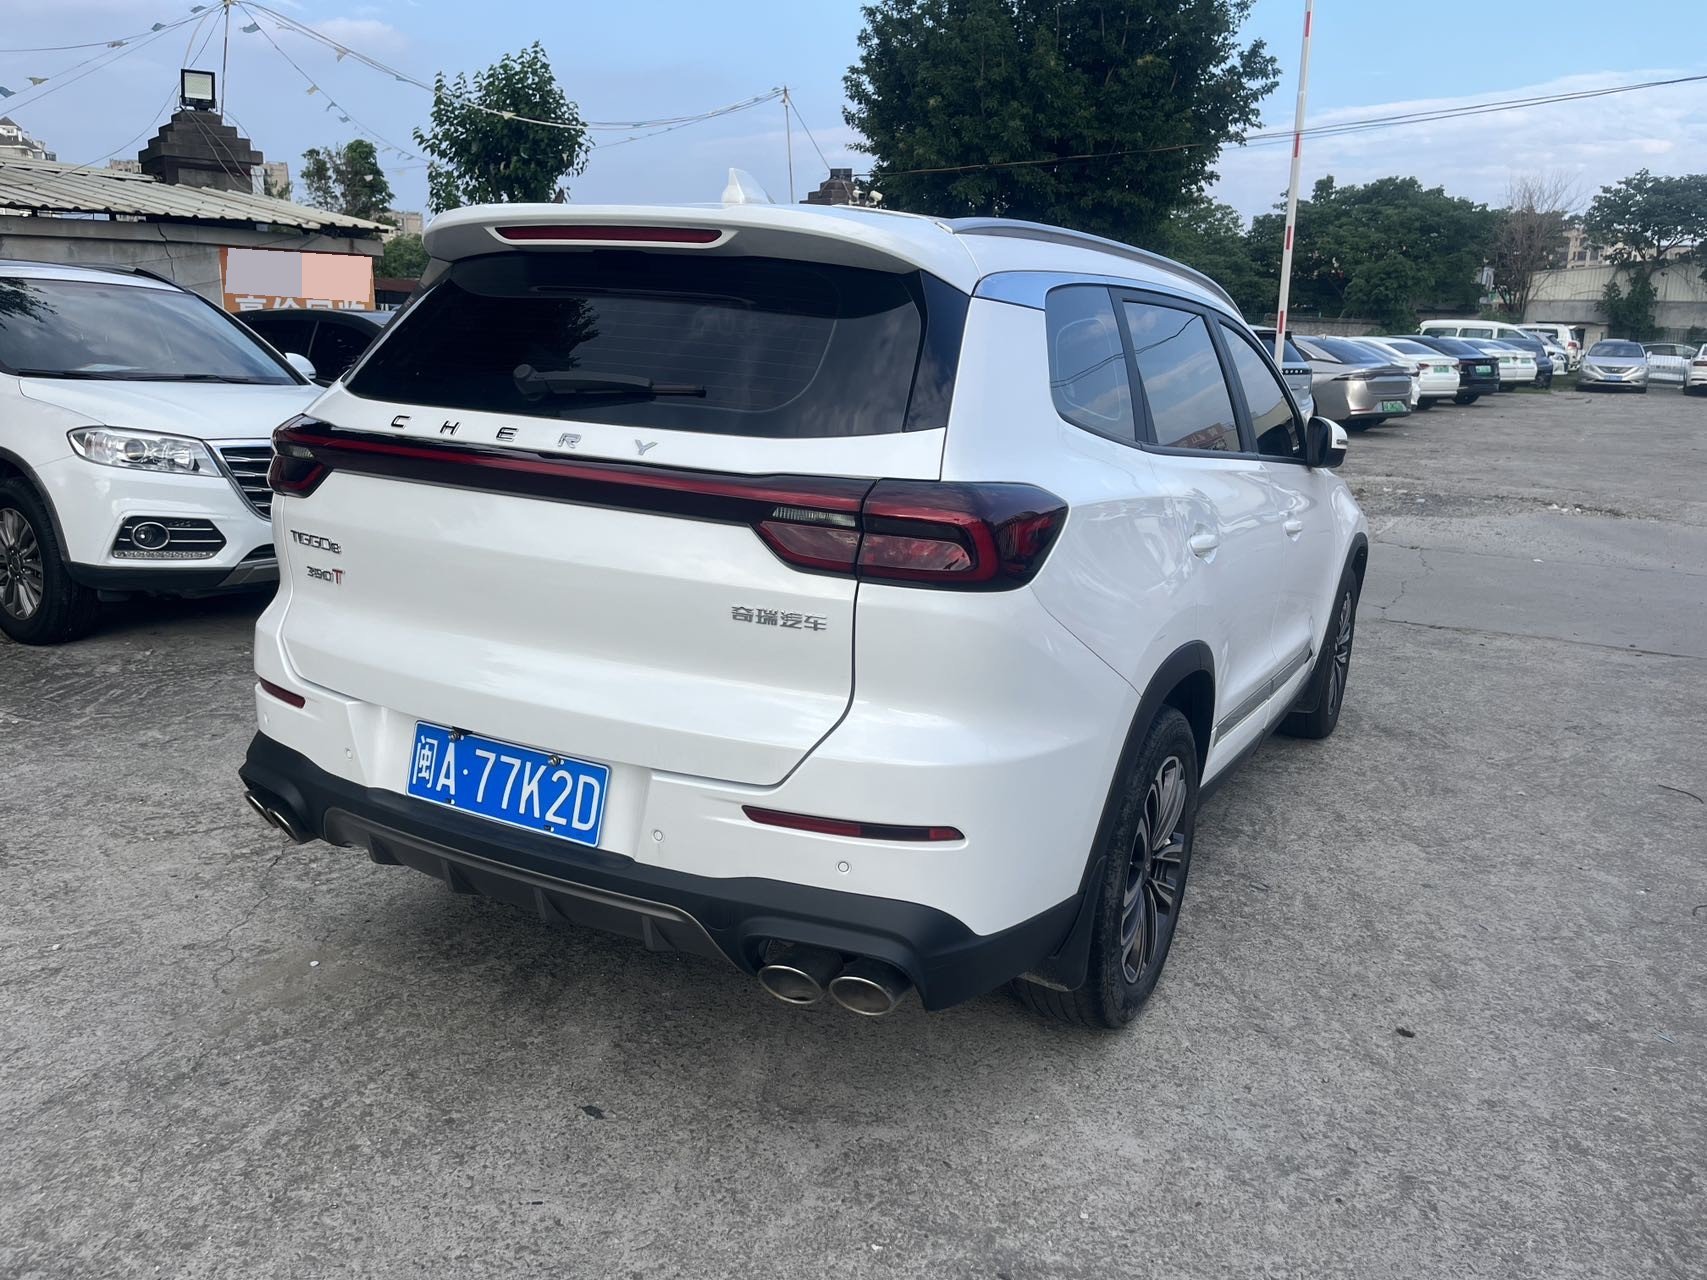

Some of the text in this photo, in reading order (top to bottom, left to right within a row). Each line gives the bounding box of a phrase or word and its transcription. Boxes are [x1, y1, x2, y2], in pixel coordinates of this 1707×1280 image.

[391, 415, 658, 456] CHERY
[731, 606, 827, 631] 奇瑞汽车
